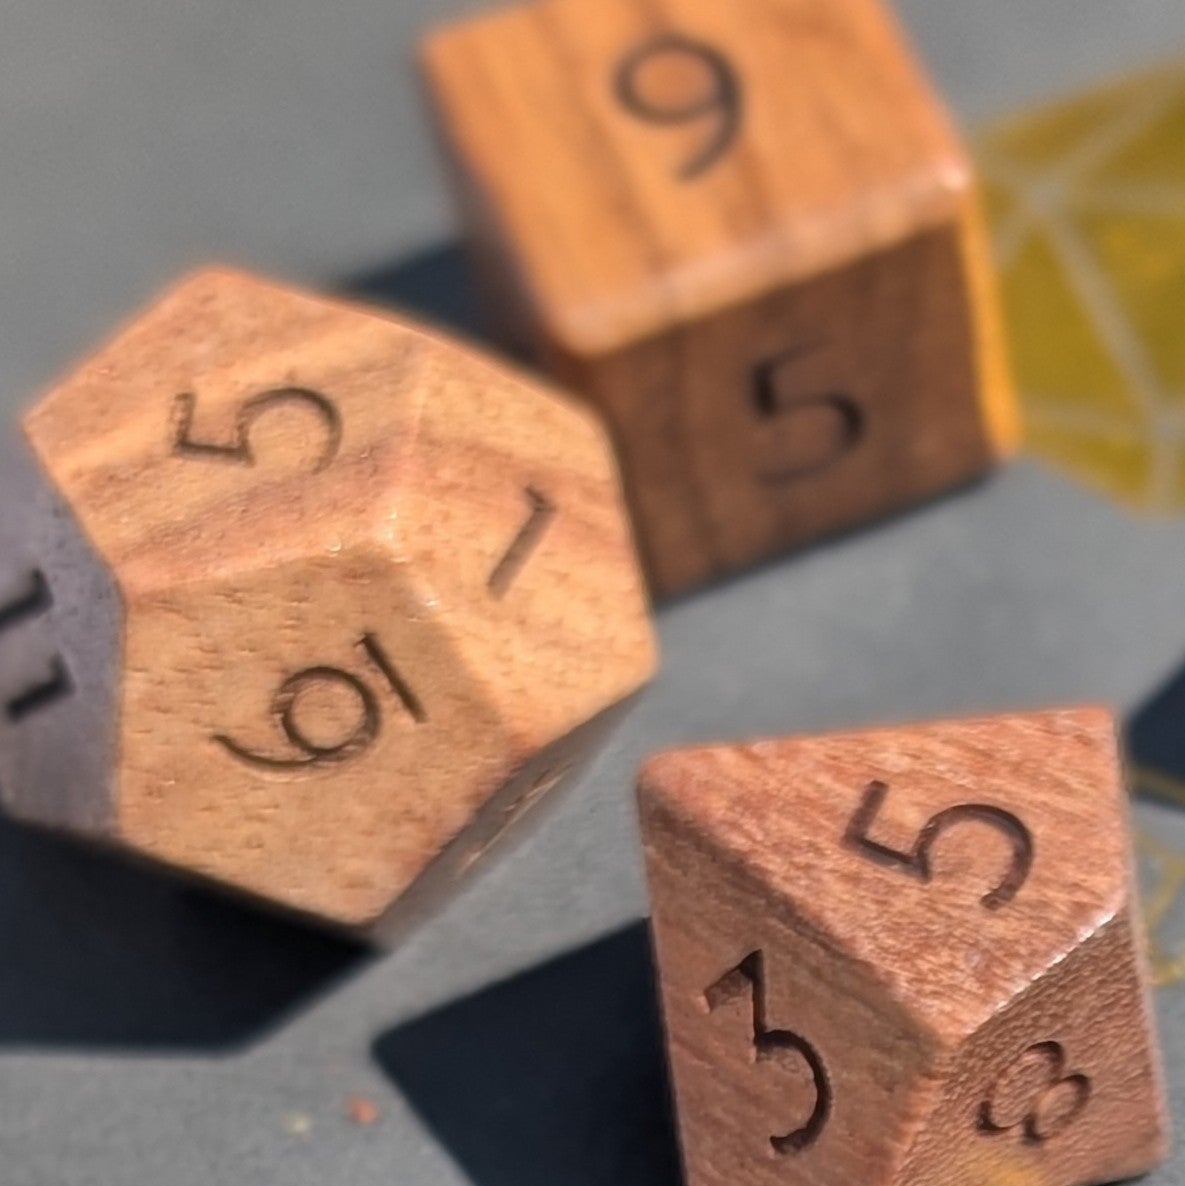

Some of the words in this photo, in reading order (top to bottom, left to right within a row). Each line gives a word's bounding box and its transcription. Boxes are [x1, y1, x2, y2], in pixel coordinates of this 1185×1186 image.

[171, 386, 344, 475] 5
[748, 335, 864, 488] 5
[487, 484, 557, 600] 1
[840, 780, 1034, 910] 5
[703, 949, 832, 1156] 3
[975, 1039, 1093, 1145] 8
